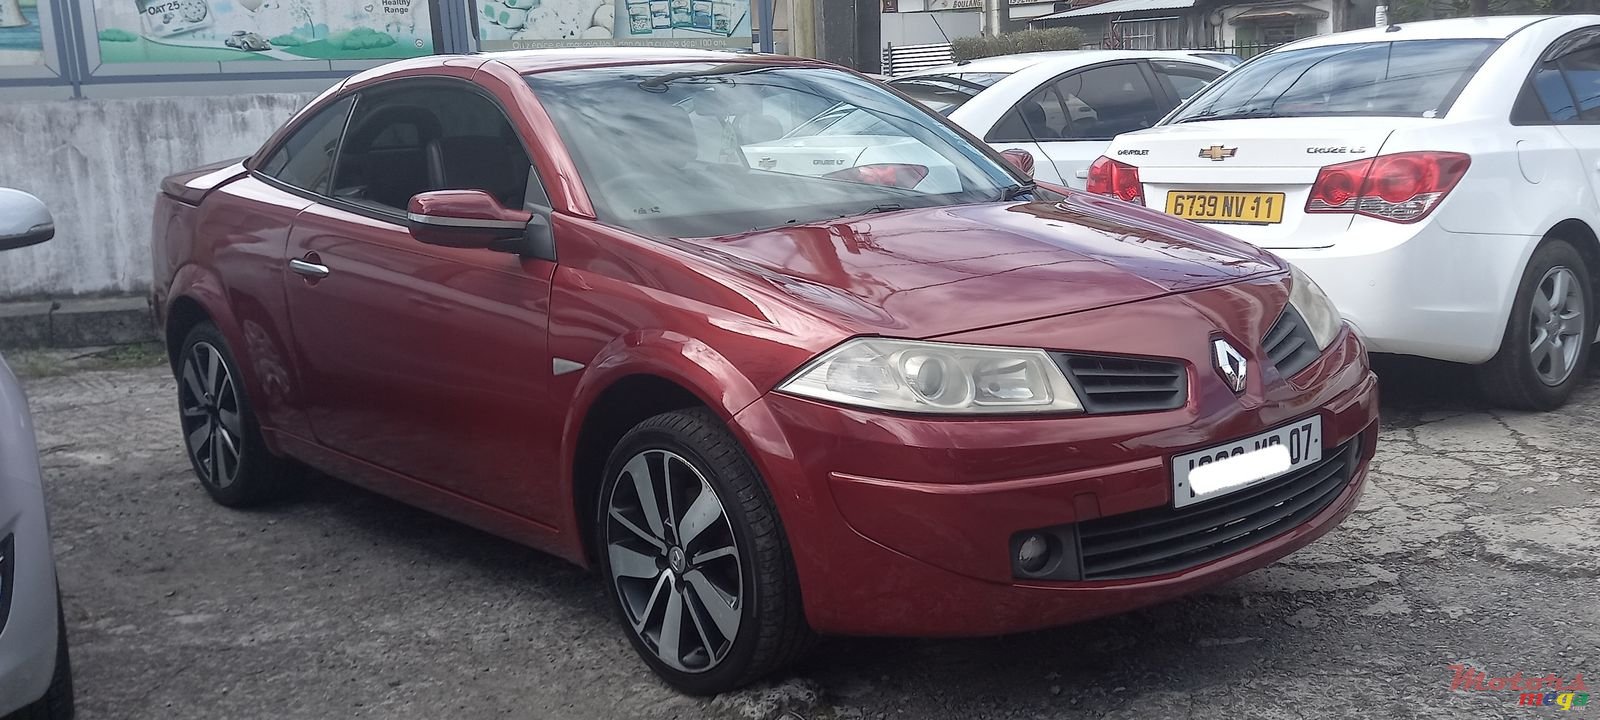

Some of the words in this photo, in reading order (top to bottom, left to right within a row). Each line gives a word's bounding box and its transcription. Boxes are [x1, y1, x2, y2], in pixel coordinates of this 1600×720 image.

[148, 4, 166, 15] OAT
[166, 0, 180, 11] 25
[953, 0, 983, 8] BOULANG
[384, 6, 409, 15] Range
[699, 38, 712, 47] 100
[1306, 146, 1347, 154] CRUZE
[1173, 194, 1217, 217] 6739
[1222, 196, 1247, 218] NV
[1289, 423, 1313, 466] 07
